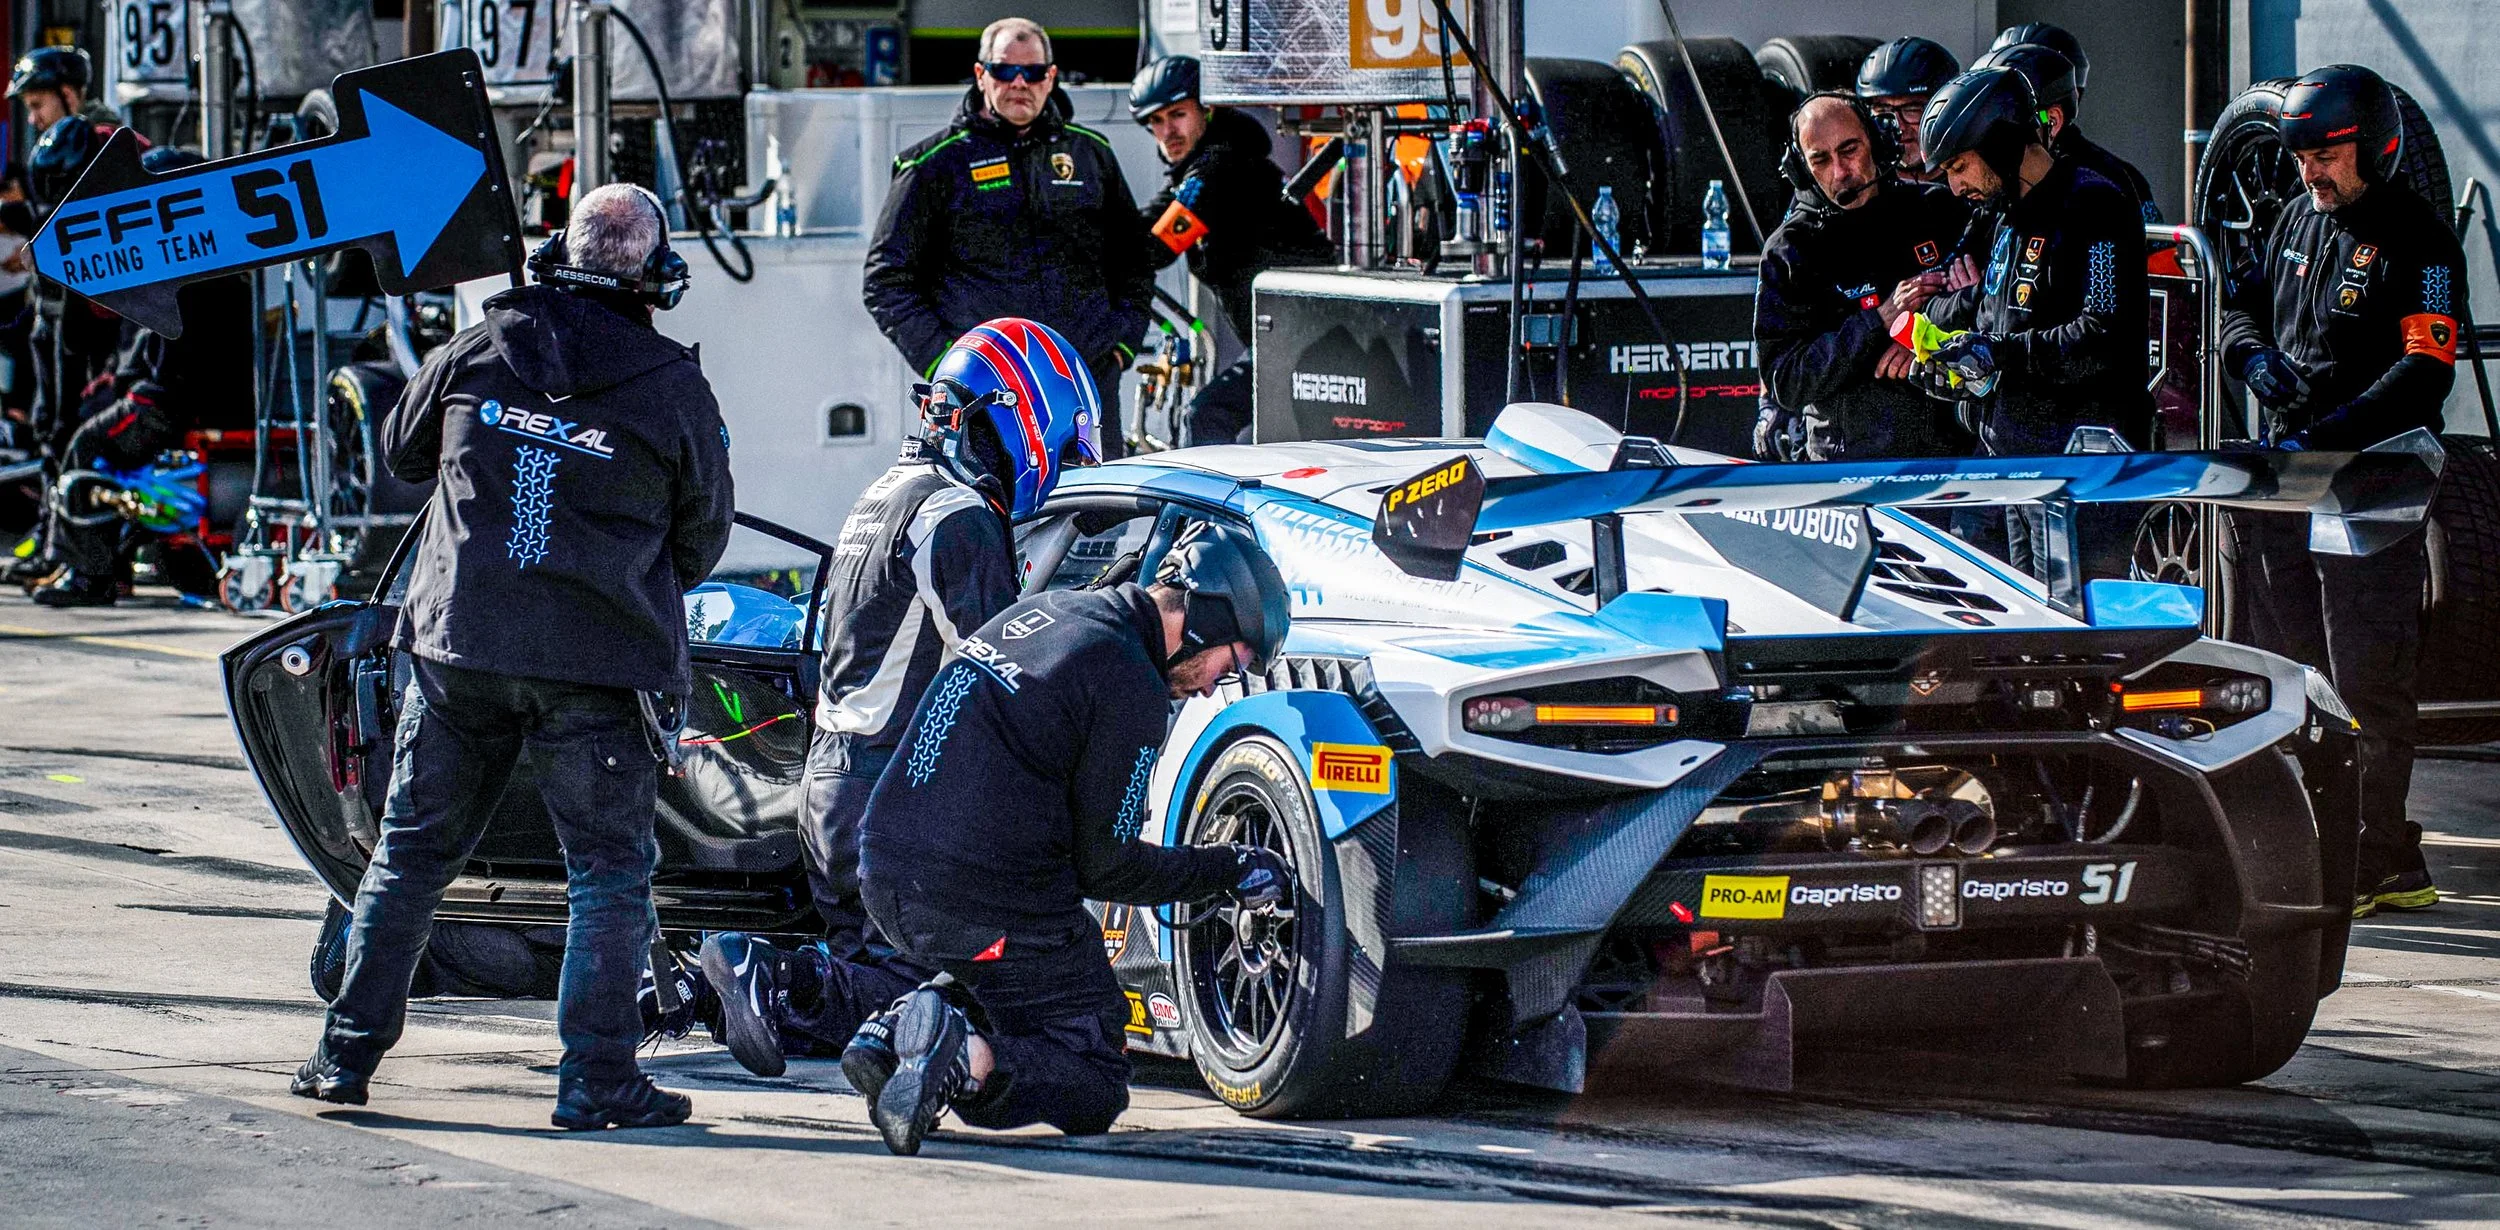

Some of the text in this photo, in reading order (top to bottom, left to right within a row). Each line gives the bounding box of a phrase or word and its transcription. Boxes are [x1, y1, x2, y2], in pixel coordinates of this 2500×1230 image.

[126, 4, 173, 68] 95
[481, 1, 534, 67] 97
[54, 187, 205, 256] FFF
[231, 159, 329, 250] 51
[63, 229, 218, 285] RACING TEAM
[554, 269, 617, 287] AESSECOM
[1843, 282, 1877, 299] EXAL
[1292, 371, 1367, 406] HERBERTH
[500, 406, 615, 454] REXAL
[1388, 461, 1468, 512] P ZERO
[1839, 471, 2042, 485] DO NOT PUSH ON THE REAR WING
[1772, 508, 1860, 551] DUBUIS
[960, 635, 1024, 690] REXAL
[1318, 751, 1383, 784] PIRELLI
[1710, 861, 2138, 908] PRO-AM Capristo Capristo 51
[676, 979, 692, 1002] OMP
[1151, 1001, 1178, 1021] BMC
